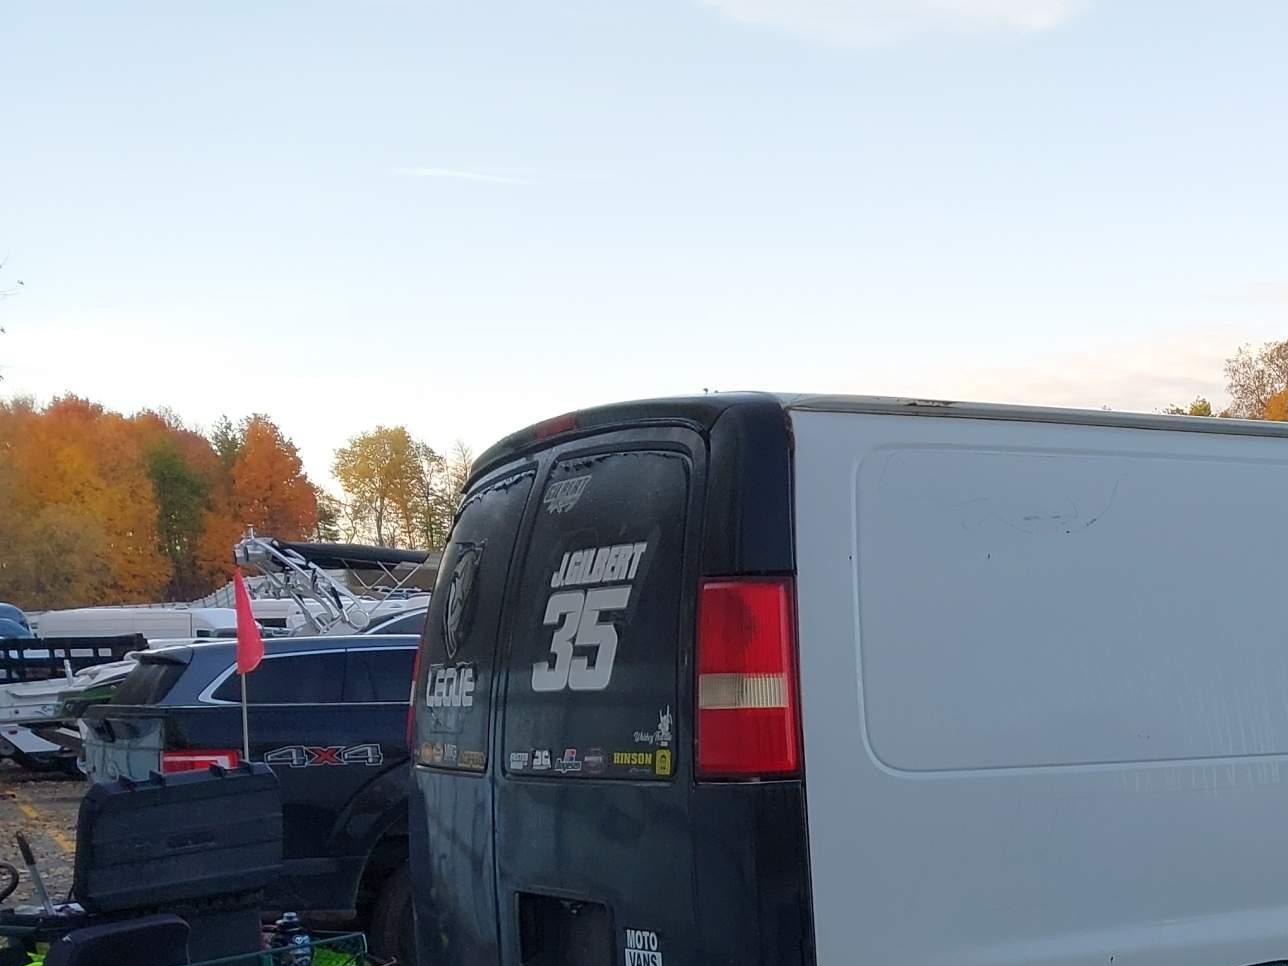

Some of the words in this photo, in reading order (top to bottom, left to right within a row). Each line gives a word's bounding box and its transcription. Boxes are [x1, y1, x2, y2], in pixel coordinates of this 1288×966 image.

[551, 541, 647, 587] J.GILBERT
[532, 585, 631, 692] 35
[613, 752, 652, 765] HINSON
[626, 929, 658, 951] MOTO
